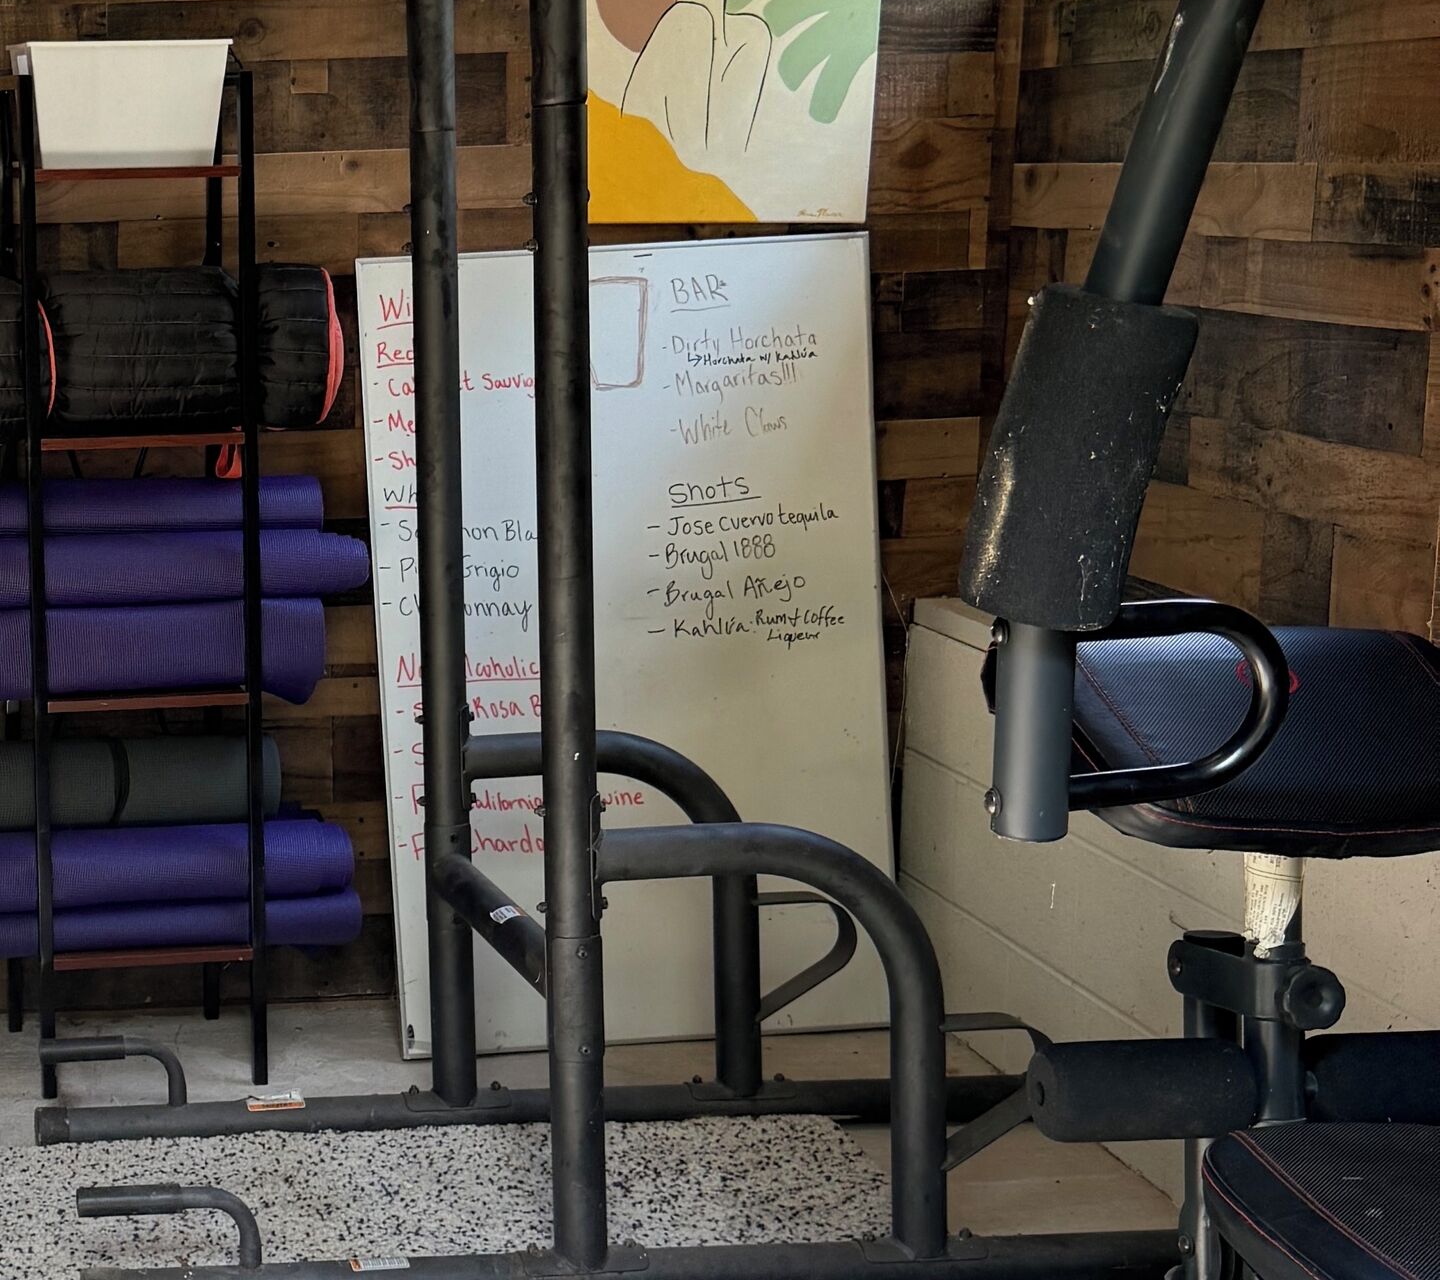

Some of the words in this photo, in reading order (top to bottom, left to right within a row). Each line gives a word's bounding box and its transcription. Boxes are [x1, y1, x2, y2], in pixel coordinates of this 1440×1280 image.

[672, 328, 720, 356] Dirty
[730, 324, 817, 351] Horchata
[703, 352, 757, 367] Horchata
[678, 409, 732, 445] White
[668, 476, 751, 505] Shots
[667, 516, 714, 536] Jose
[778, 503, 839, 532] tequila
[665, 541, 729, 580] Brugal
[733, 533, 776, 559] 1888
[663, 580, 734, 621] Brugal
[755, 609, 787, 626] Rum
[804, 605, 845, 628] Coffee
[472, 696, 525, 719] Rosa
